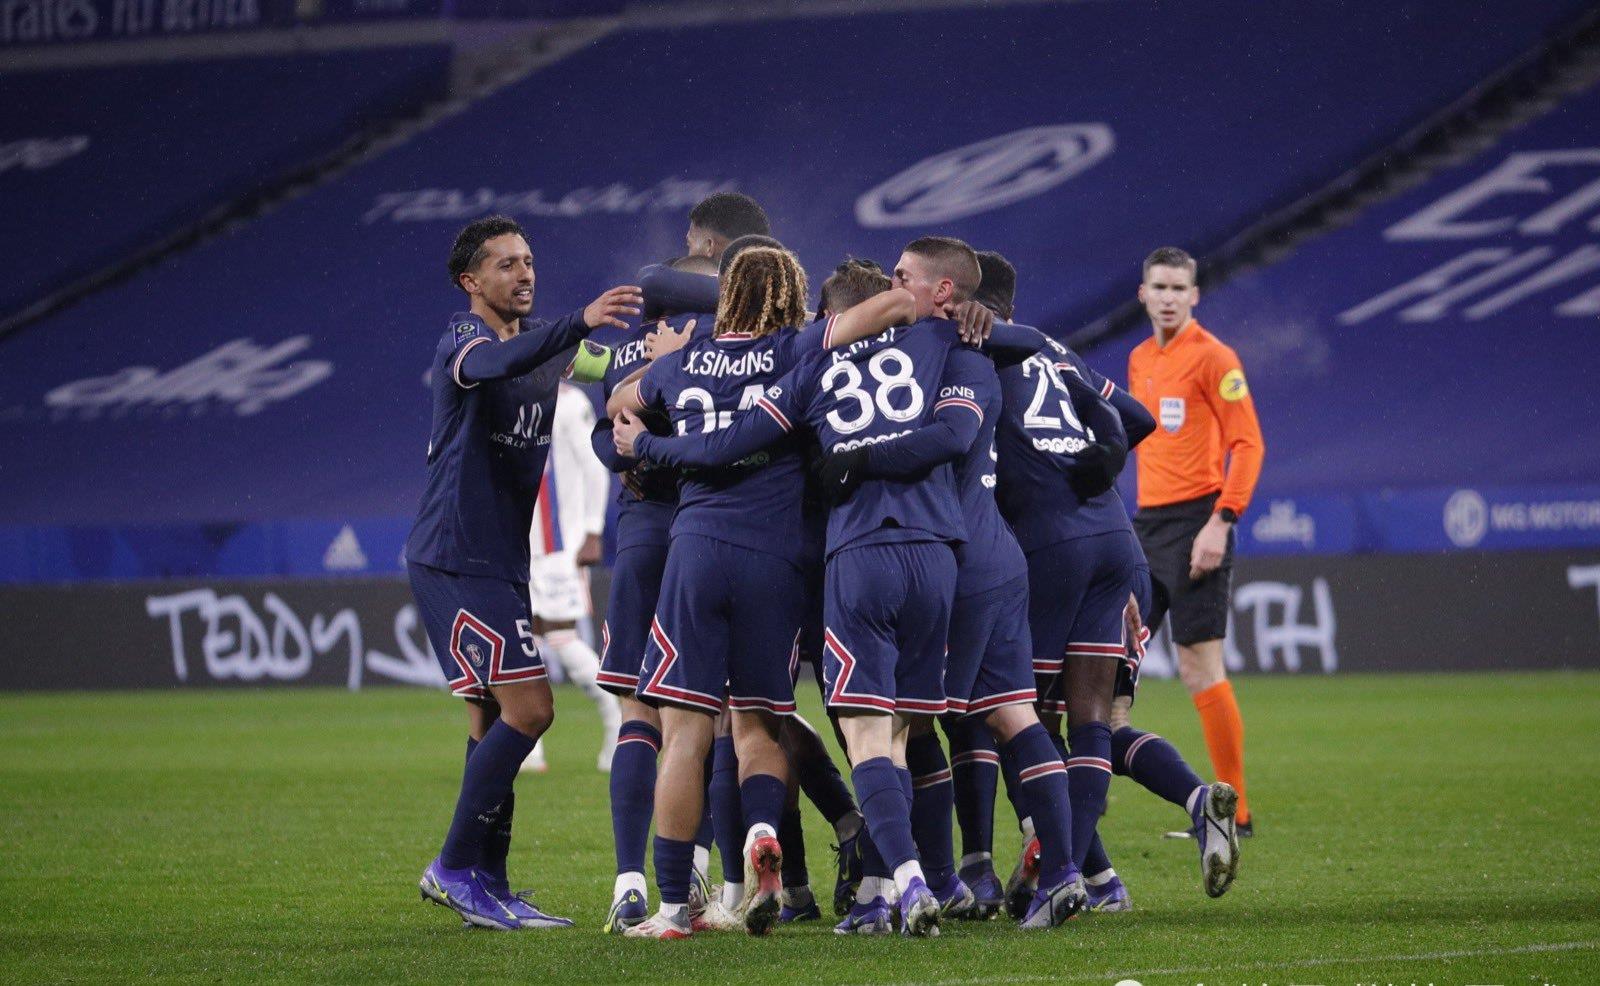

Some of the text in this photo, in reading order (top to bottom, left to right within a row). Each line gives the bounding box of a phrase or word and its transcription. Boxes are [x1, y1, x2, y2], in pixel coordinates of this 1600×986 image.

[0, 0, 97, 41] rates
[614, 339, 645, 370] KEH
[821, 347, 924, 434] 38
[940, 386, 975, 400] QNB
[146, 589, 361, 691] TEDDY
[516, 619, 538, 657] 5
